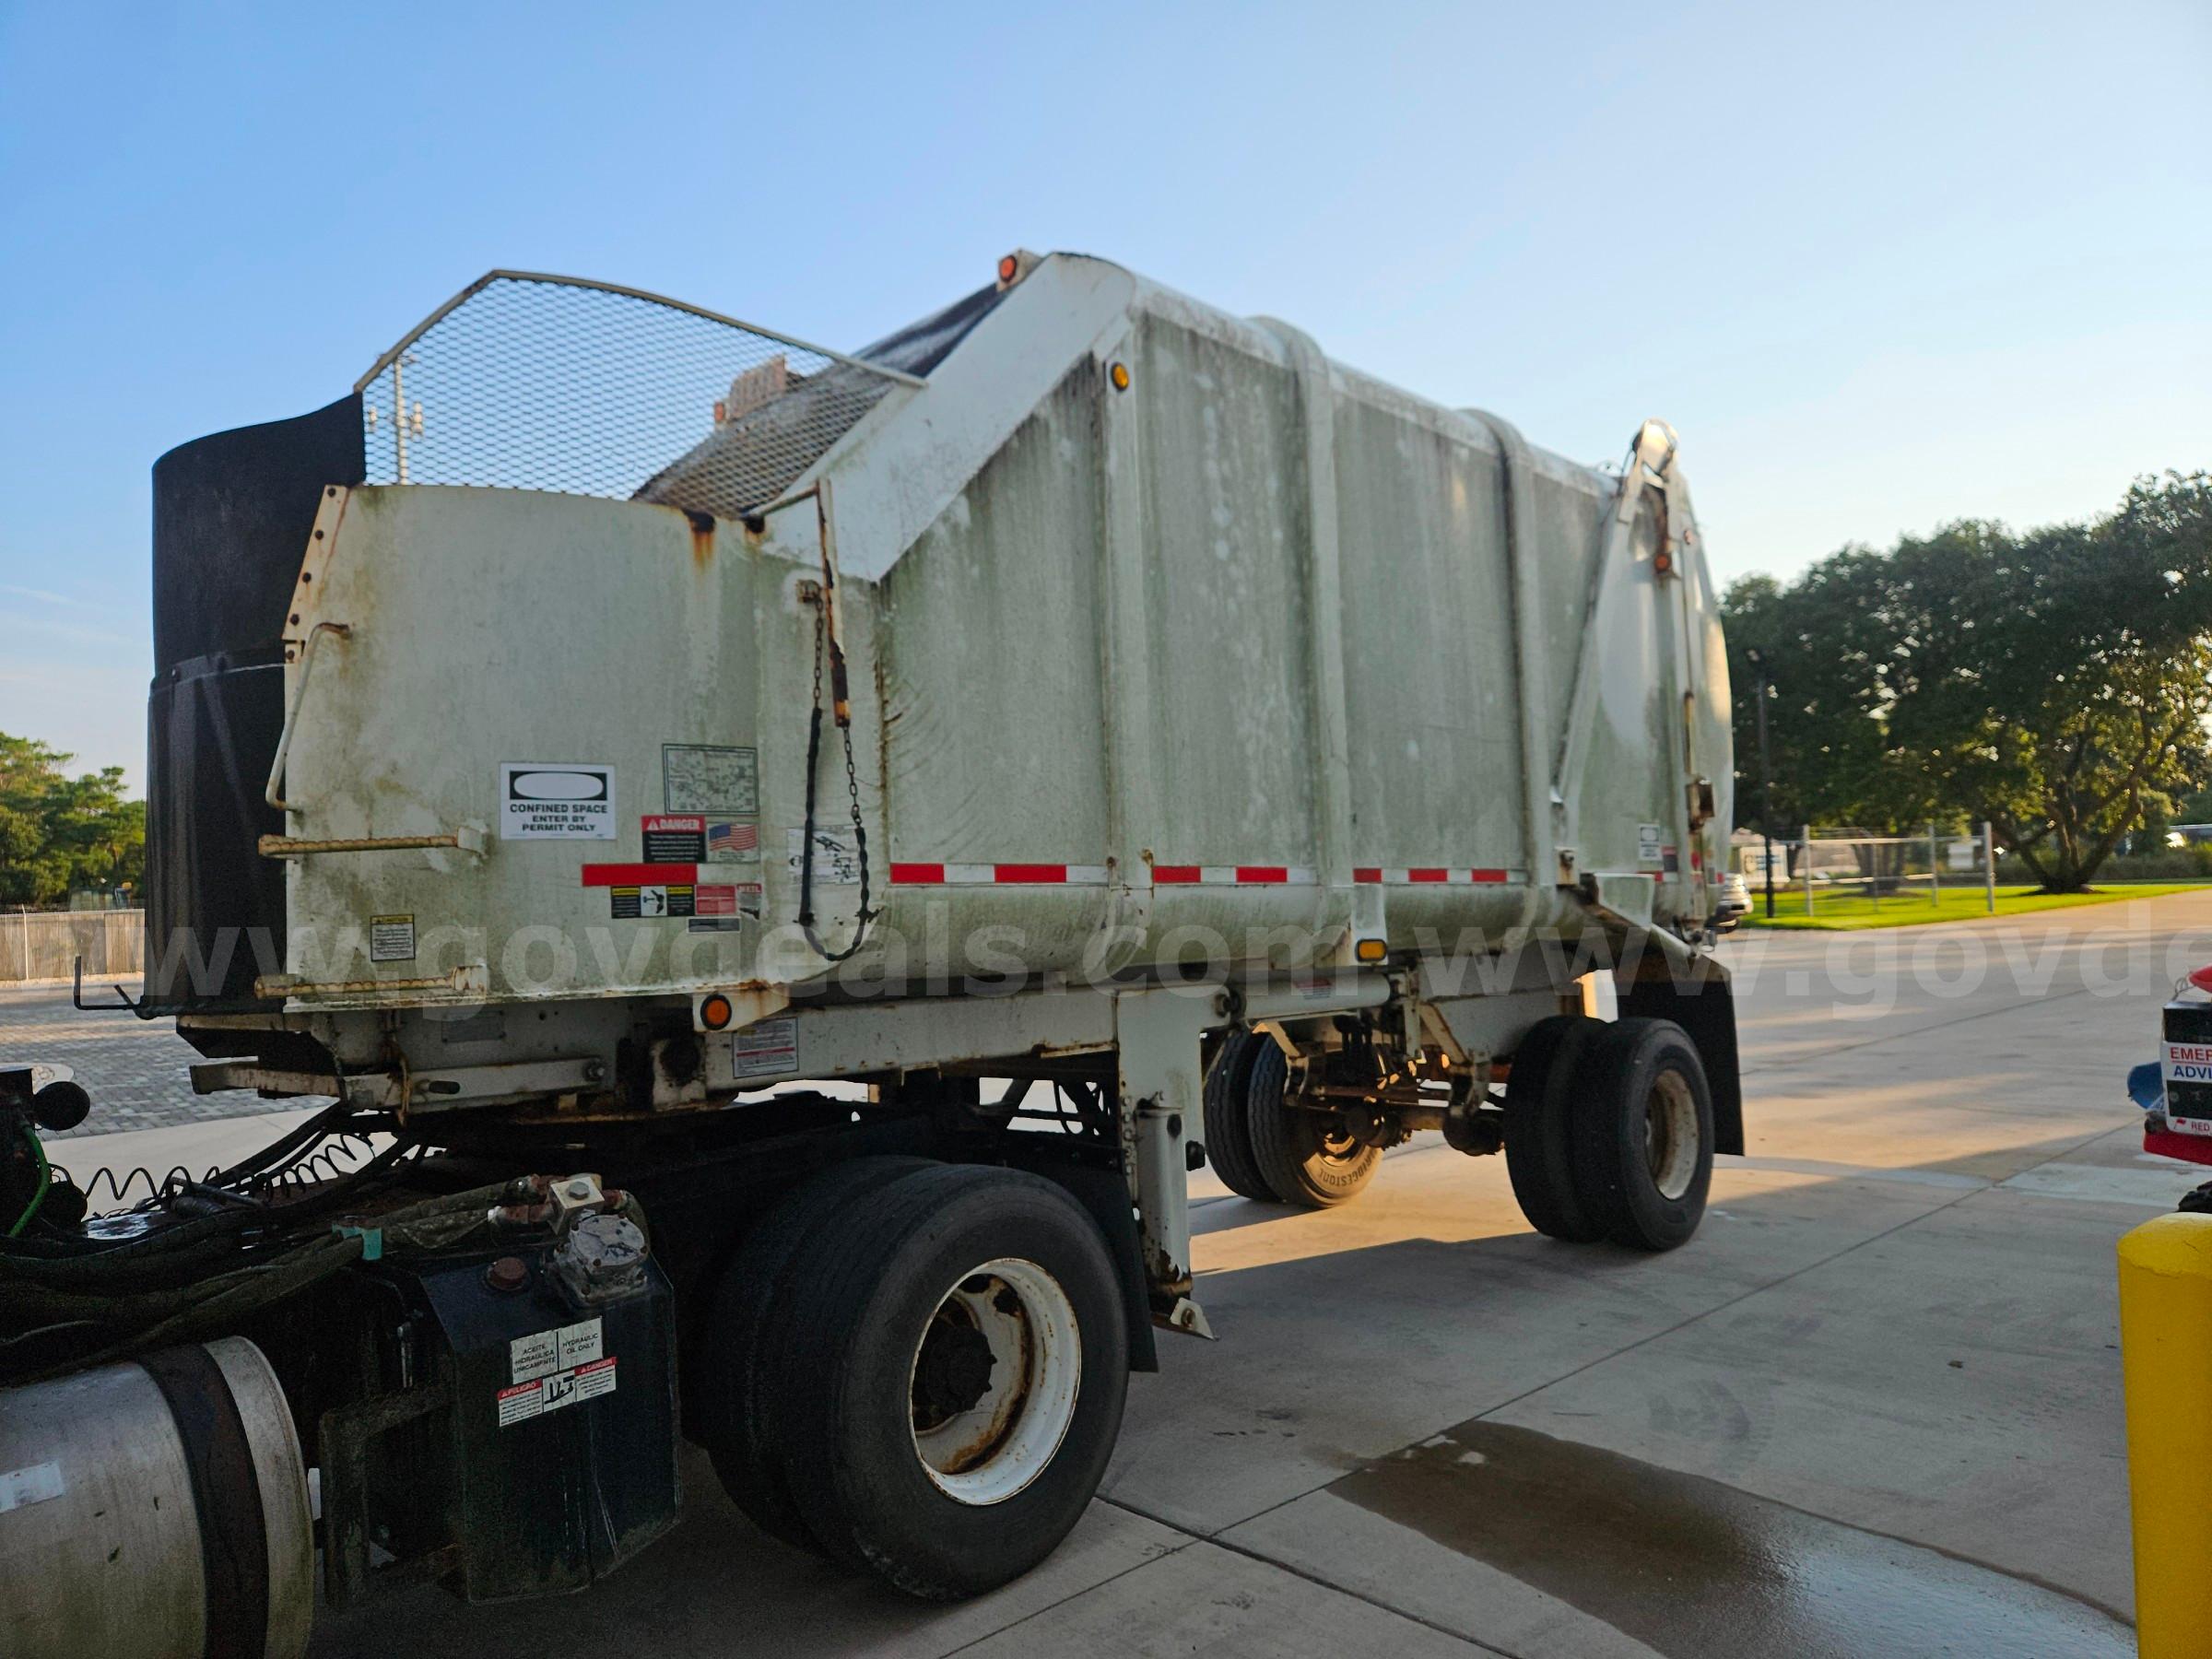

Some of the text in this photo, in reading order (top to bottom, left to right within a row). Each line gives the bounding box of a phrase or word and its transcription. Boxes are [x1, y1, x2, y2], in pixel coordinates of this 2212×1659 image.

[510, 804, 608, 814] CONFINED SPACE
[532, 815, 587, 823] ENTER BY
[660, 818, 700, 831] DANGER
[522, 823, 565, 831] PERMIT
[2191, 1121, 2210, 1132] RED
[562, 1333, 598, 1348] HYDRAULIC
[523, 1344, 547, 1355] ACEITE
[566, 1341, 595, 1355] OIL ONLY
[515, 1349, 555, 1365] HIDRAULICA
